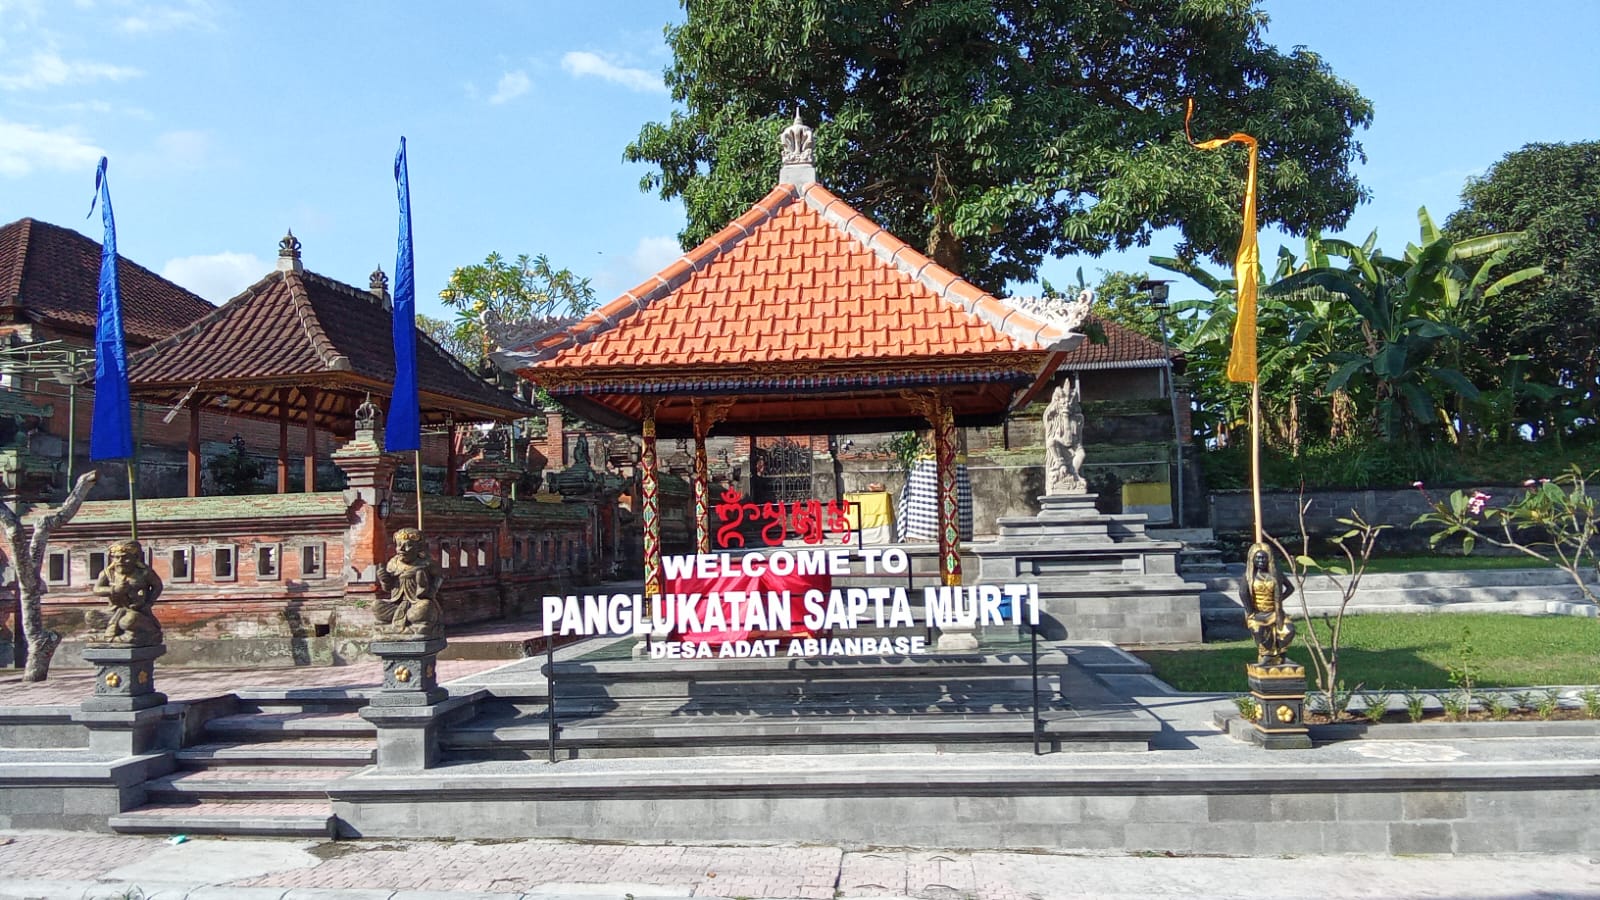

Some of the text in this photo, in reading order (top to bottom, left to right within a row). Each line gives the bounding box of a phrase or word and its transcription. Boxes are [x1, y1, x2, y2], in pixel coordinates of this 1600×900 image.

[661, 548, 908, 580] WELCOME TO
[542, 583, 1039, 636] PANGLUKATAN SAPTA MURTI
[650, 636, 926, 659] DESA ADAT ABIANBASE
